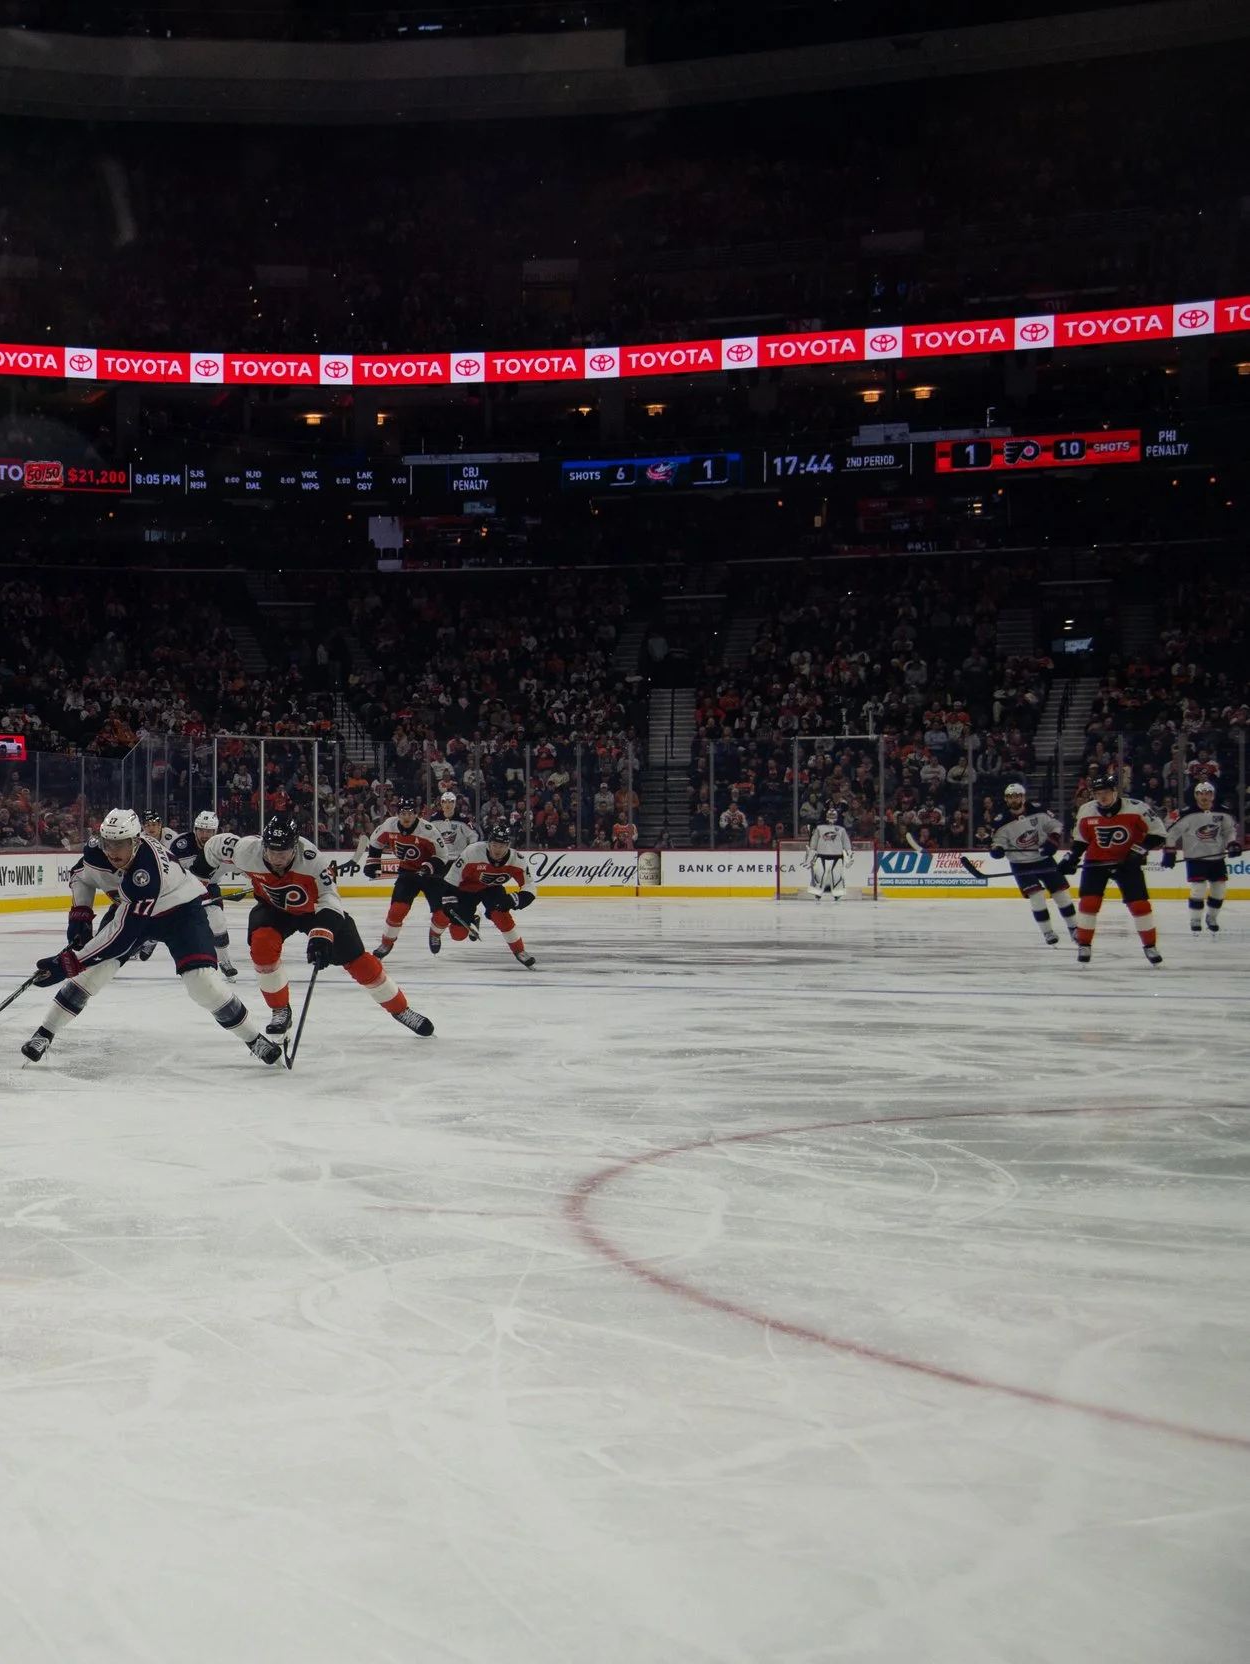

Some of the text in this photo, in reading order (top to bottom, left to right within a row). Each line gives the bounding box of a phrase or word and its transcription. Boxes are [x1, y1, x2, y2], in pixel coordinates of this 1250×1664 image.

[104, 358, 182, 374] TOYOTA
[231, 362, 312, 376] TOYOTA
[361, 362, 442, 377] TOYOTA
[493, 357, 576, 374] TOYOTA
[628, 349, 713, 368] TOYOTA
[766, 338, 855, 358] TOYOTA
[912, 328, 1005, 348] TOYOTA
[1064, 315, 1162, 337] TOYOTA
[1159, 430, 1176, 442] PHI
[1060, 441, 1080, 455] 10
[1093, 441, 1130, 453] SHOTS
[1146, 444, 1189, 457] PENALTY
[846, 455, 894, 467] 2ND PERIOD
[965, 444, 975, 465] 1
[702, 460, 712, 479] 1
[773, 454, 834, 476] 17:44
[68, 468, 126, 485] $21,200
[463, 467, 479, 478] CBJ
[569, 471, 601, 481] SHOTS
[616, 467, 626, 480] 6
[135, 474, 181, 485] 8:05 PM
[453, 480, 489, 491] PENALTY
[529, 852, 638, 884] Yuengling
[679, 864, 796, 873] BANK OF AMERICA
[875, 852, 933, 874] KDI
[8, 870, 15, 883] TO
[16, 865, 35, 885] WIN!
[133, 899, 155, 916] 17
